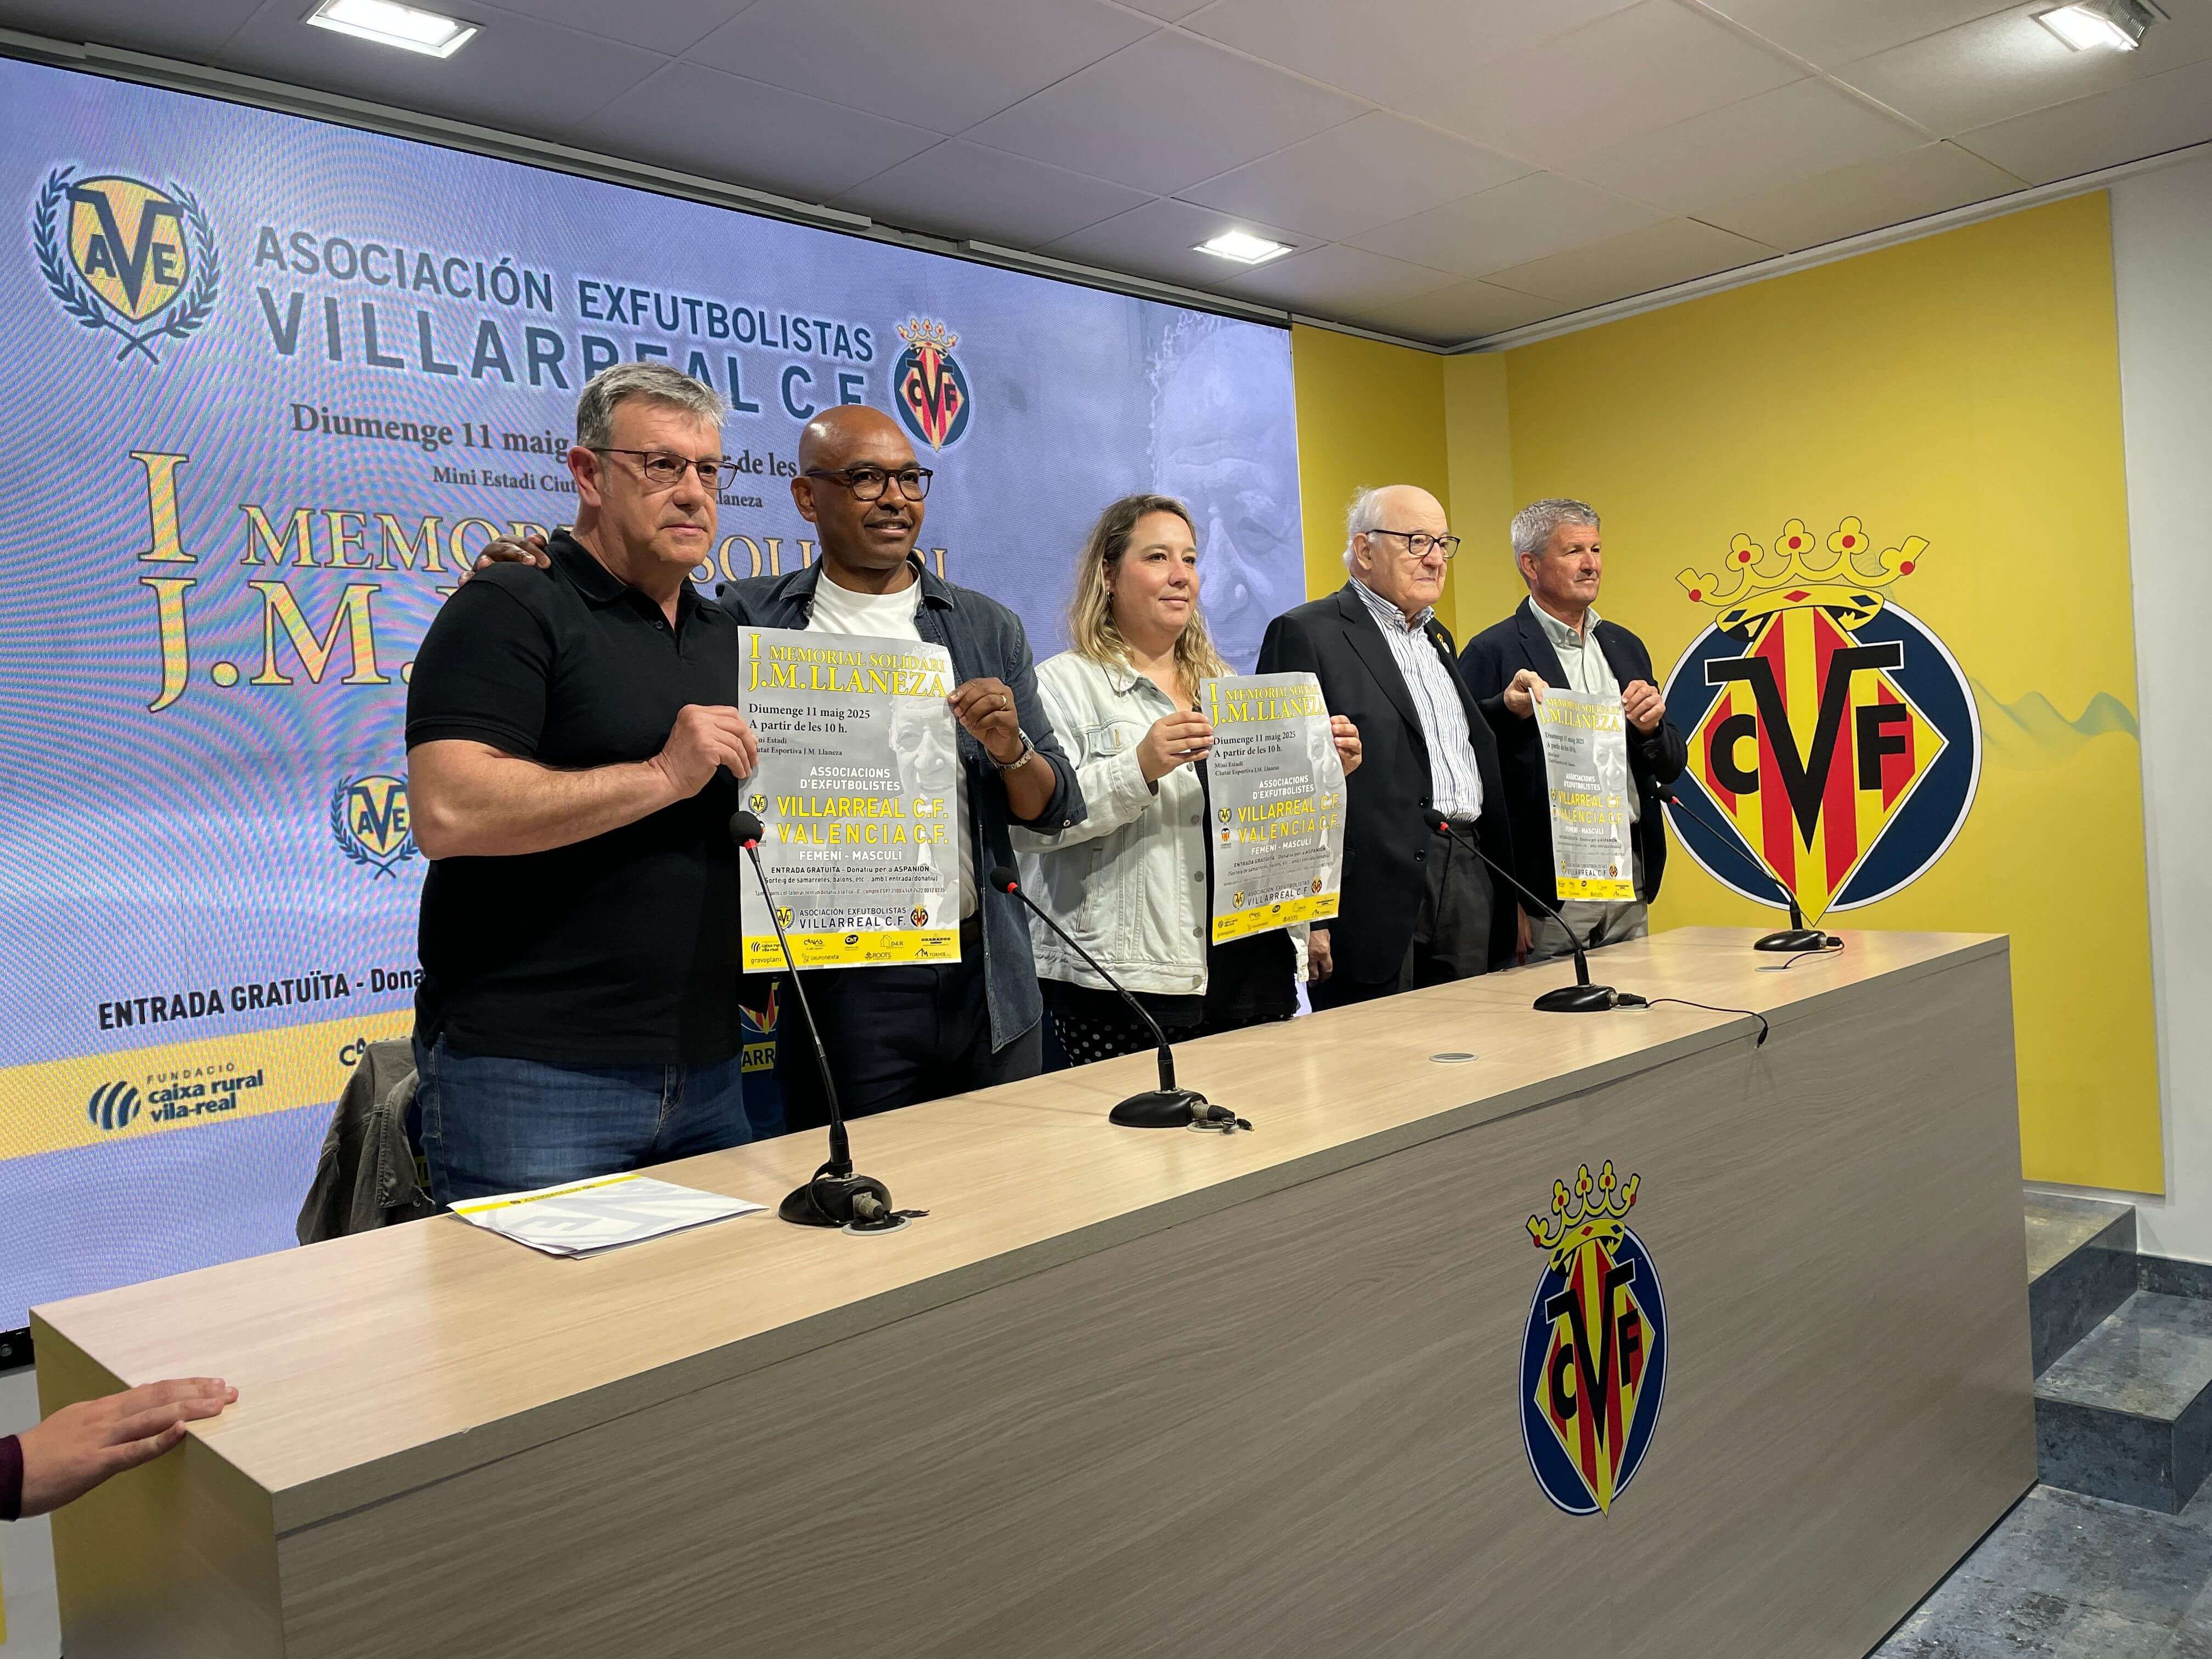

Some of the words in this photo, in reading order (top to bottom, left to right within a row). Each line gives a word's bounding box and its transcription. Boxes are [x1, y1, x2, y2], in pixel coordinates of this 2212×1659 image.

[255, 225, 553, 312] ASOCIACIÓN
[579, 280, 873, 362] EXFUTBOLISTAS
[291, 403, 453, 452] Diumenge
[462, 422, 493, 448] 11
[503, 430, 568, 464] maig
[738, 450, 763, 475] de
[768, 452, 797, 478] les
[433, 466, 476, 485] Mini
[481, 470, 536, 490] Estadi
[540, 475, 578, 494] Ciut
[716, 489, 763, 507] laneza
[129, 450, 198, 564] I
[749, 634, 761, 659] I
[769, 645, 865, 666] MEMORIAL
[870, 653, 946, 673] SOLIDARI
[1208, 682, 1219, 702] I
[1225, 686, 1288, 701] MEMORIAL
[749, 703, 803, 718] Diumenge
[806, 707, 816, 716] 11
[820, 708, 844, 720] maig
[847, 709, 870, 719] 2025
[749, 719, 758, 729] A
[761, 721, 791, 731] partir
[794, 721, 805, 731] de
[809, 722, 821, 731] les
[825, 724, 836, 732] 10
[838, 724, 847, 733] h.
[1214, 736, 1254, 746] Diumenge
[1265, 733, 1280, 742] maig
[1282, 731, 1296, 739] 2025
[771, 747, 802, 755] Esportiva
[1214, 749, 1221, 758] A
[1223, 748, 1245, 759] partir
[1248, 747, 1255, 755] de
[1257, 746, 1266, 754] les
[1268, 745, 1275, 753] 10
[810, 766, 890, 778] ASSOCIACIONS
[800, 778, 900, 791] D'EXFUTBOLISTES
[1259, 775, 1309, 789] ASSOCIACIONS
[1252, 784, 1314, 800] D'EXFUTBOLISTES
[1558, 790, 1604, 808] VILLARREAL
[777, 796, 905, 818] VILLARREAL
[912, 798, 949, 819] C.F.
[1238, 798, 1316, 823] VILLARREAL
[1321, 793, 1341, 810] C.F.
[777, 823, 907, 844] VALENCIA
[913, 824, 949, 844] C.F.
[1238, 817, 1316, 844] VALENCIA
[1319, 813, 1339, 831] C.F.
[799, 848, 842, 861] FEMENÍ
[852, 848, 902, 861] MASCULÍ
[1248, 890, 1294, 906] VILLARREAL
[799, 907, 844, 916] ASOCIACIÓN
[848, 906, 907, 916] EXFUTBOLISTAS
[799, 916, 881, 929] VILLARREAL
[885, 916, 906, 926] C.F.
[99, 989, 224, 1030] ENTRADA
[231, 970, 349, 1012] GRATUÏTA
[371, 968, 424, 993] Dona
[148, 1082, 206, 1104] caixa
[211, 1069, 264, 1094] rural
[150, 1093, 236, 1122] vila-real
